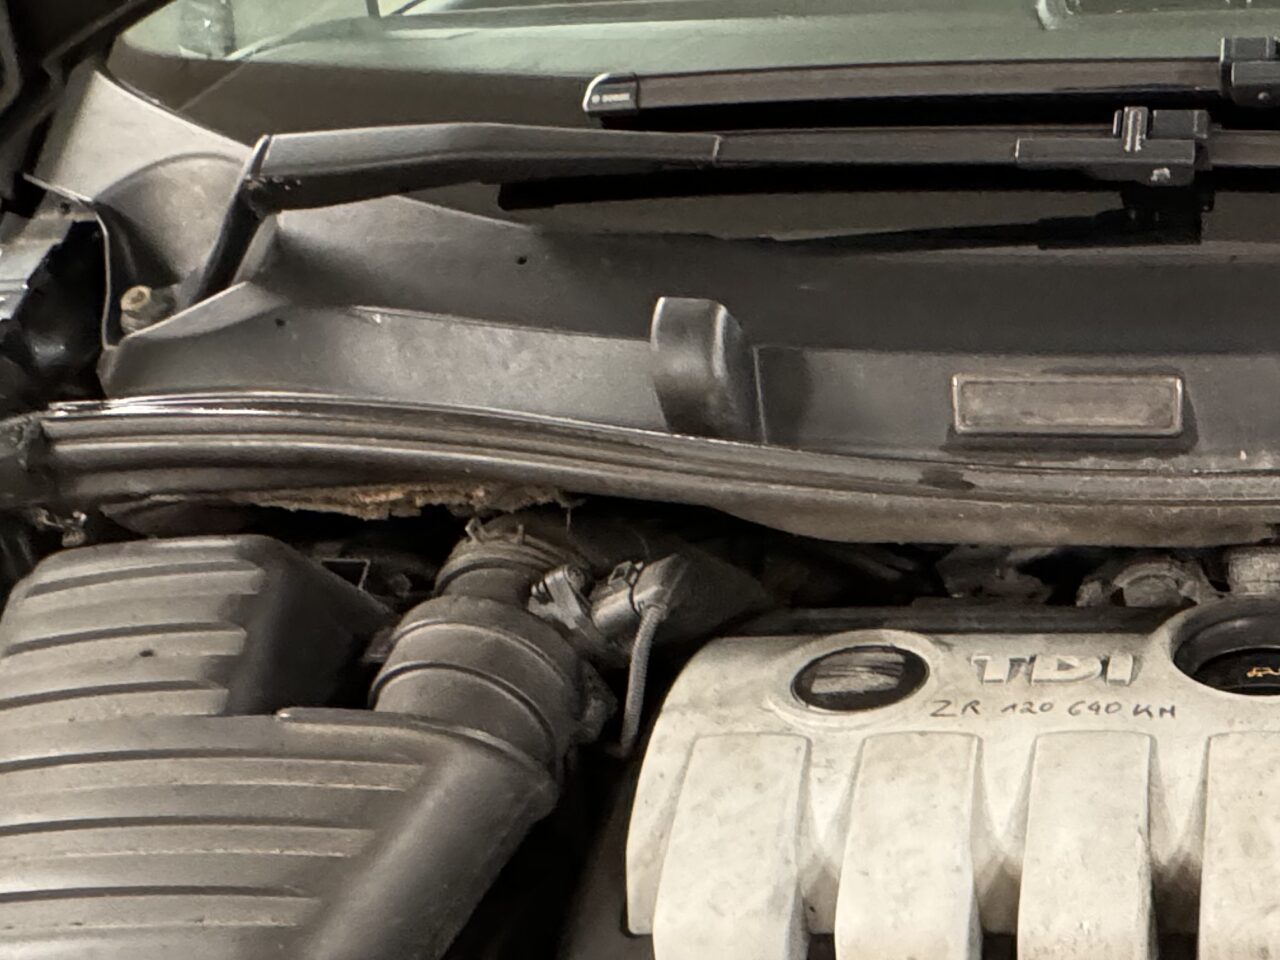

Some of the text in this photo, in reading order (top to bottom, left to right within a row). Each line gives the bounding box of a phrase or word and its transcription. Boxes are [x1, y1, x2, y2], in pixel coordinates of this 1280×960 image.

[971, 654, 1140, 685] TDI
[930, 700, 981, 717] ZR
[1001, 700, 1054, 714] 120
